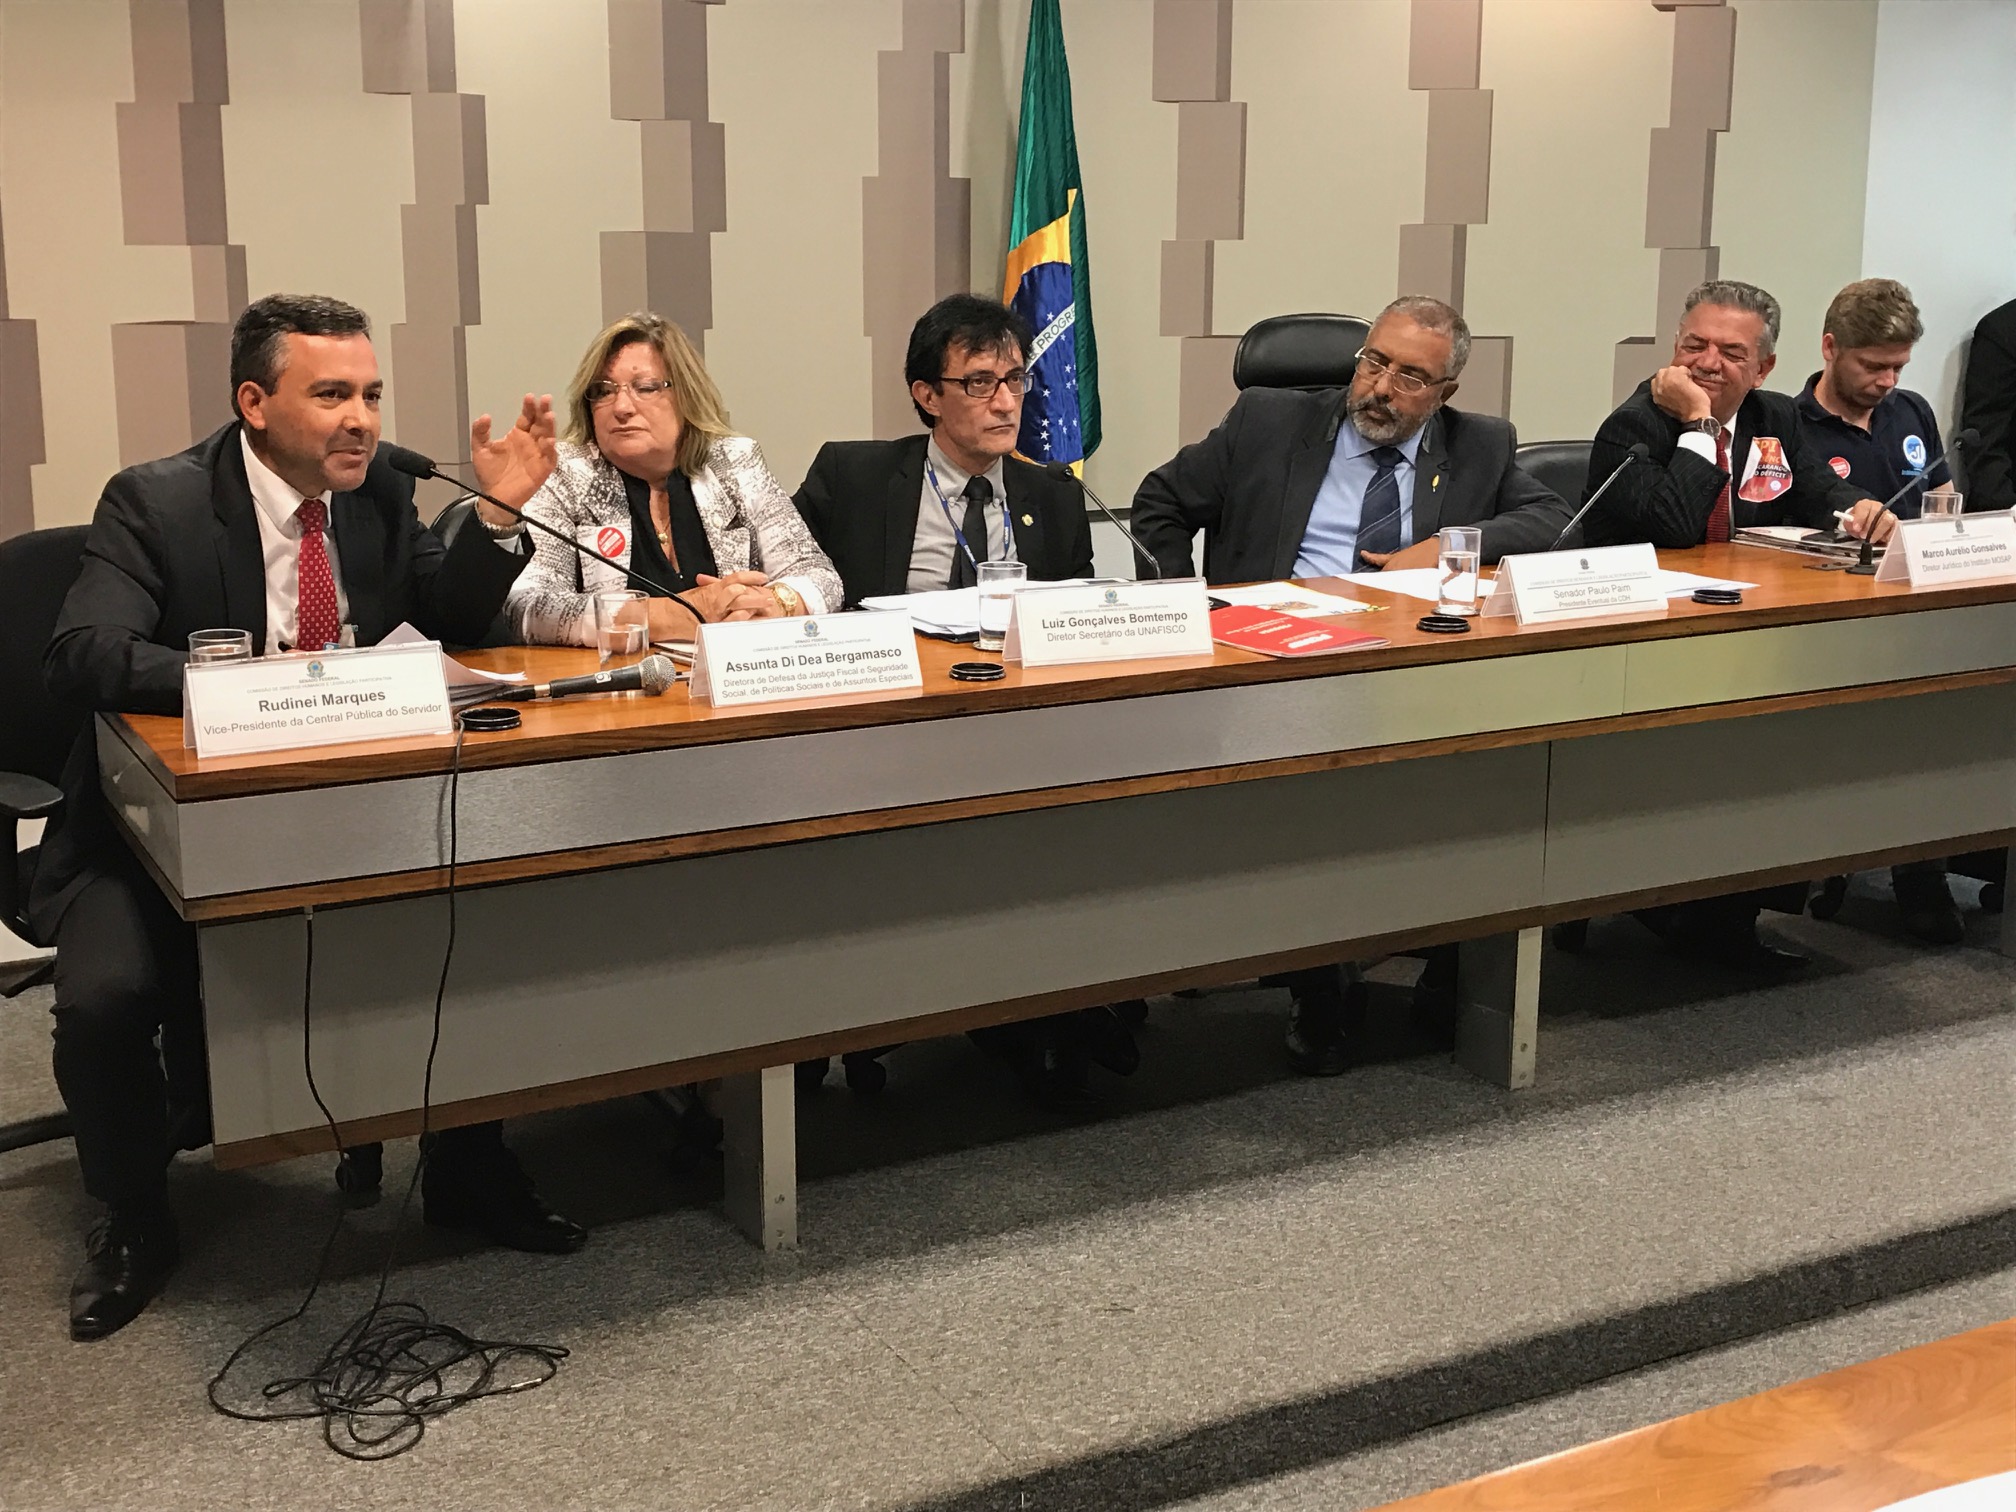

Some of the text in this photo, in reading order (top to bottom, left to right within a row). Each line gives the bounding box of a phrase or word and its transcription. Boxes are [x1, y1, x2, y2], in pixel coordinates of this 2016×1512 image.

[1922, 549, 1944, 558] Marco
[1946, 546, 1970, 556] Aurélio
[1554, 584, 1631, 599] Senador Paulo Paim
[1042, 611, 1188, 629] Luiz Gonçalves Bomtempo
[1047, 624, 1186, 642] Diretor Secretário da UNAFISCO
[725, 647, 902, 673] Assunta Di Dea Bergamasco
[723, 679, 754, 688] Diretora
[757, 676, 766, 684] de
[768, 674, 795, 683] Defesa
[809, 670, 835, 679] Justiça
[836, 666, 858, 676] Fiscal
[867, 663, 908, 674] Seguridade
[763, 684, 794, 694] Políticas
[796, 681, 824, 691] Sociais
[843, 677, 877, 686] Assuntos
[879, 673, 913, 683] Especiais
[258, 690, 386, 713] Rudinei Marques
[204, 703, 442, 736] Vice-Presidente da Central Pública do Servidor
